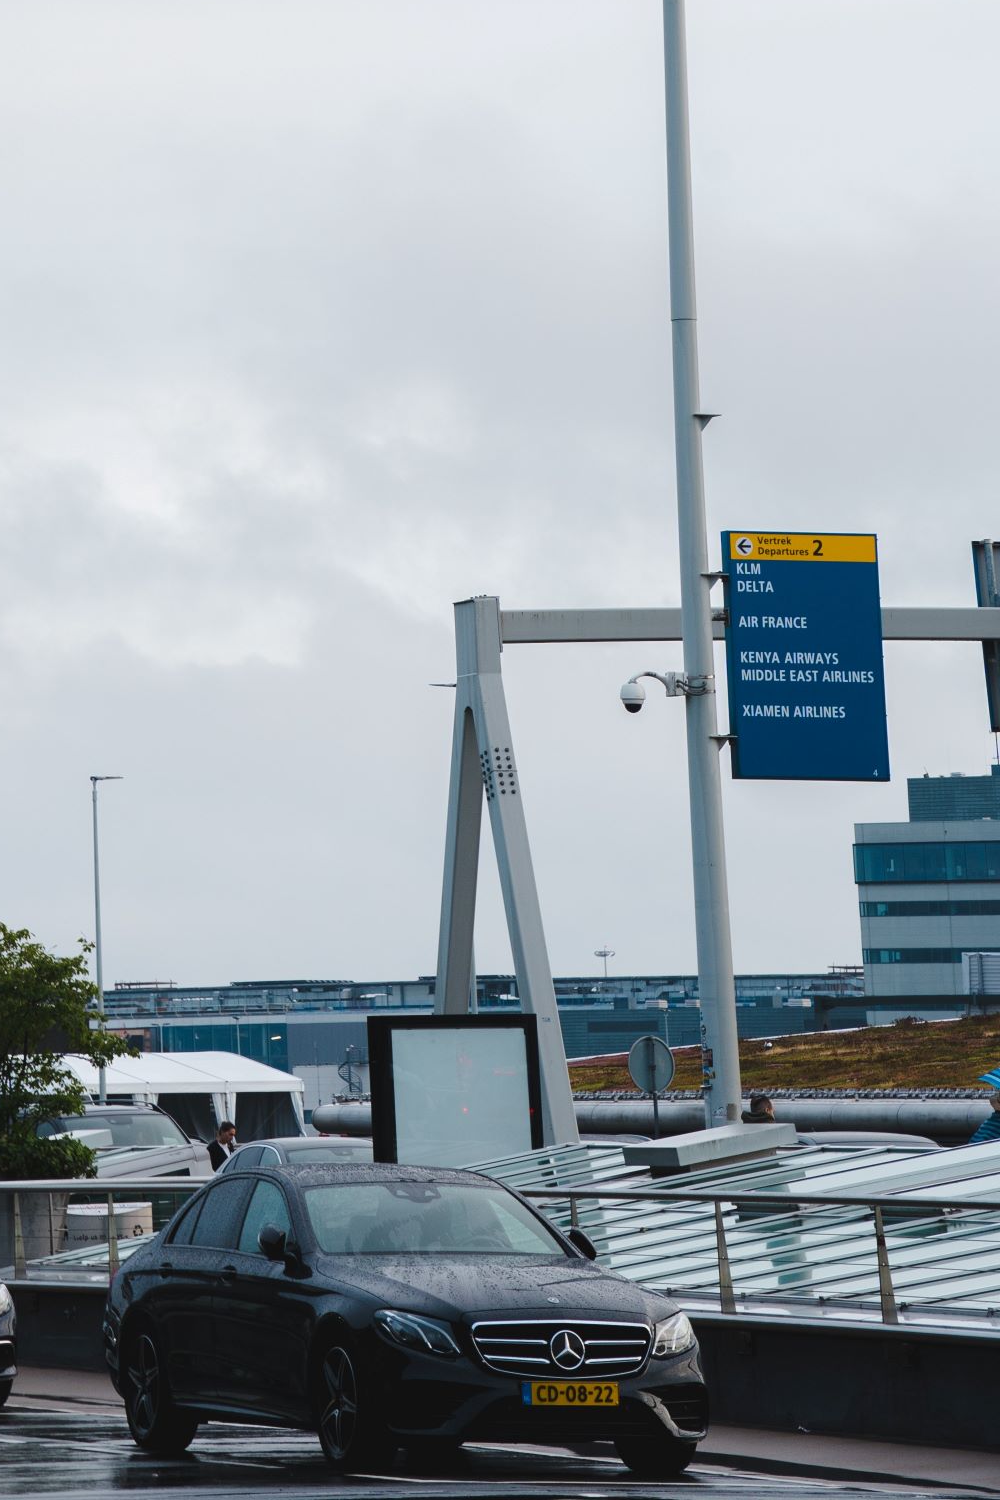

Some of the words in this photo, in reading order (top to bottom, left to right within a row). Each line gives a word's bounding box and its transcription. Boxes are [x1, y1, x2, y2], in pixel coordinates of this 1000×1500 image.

[758, 536, 791, 545] Vertrek
[758, 547, 809, 557] Departures
[812, 540, 823, 556] 2
[736, 563, 761, 575] KLM
[737, 580, 774, 592] DELTA
[739, 616, 758, 628] AIR
[762, 616, 807, 629] FRANCE
[740, 652, 780, 664] KENYA
[785, 652, 839, 665] AIRWAYS
[741, 670, 786, 681] MIDDLE
[790, 670, 819, 682] EAST
[823, 671, 874, 683] AIRLINES
[743, 705, 790, 717] XIAMEN
[794, 706, 845, 718] AIRLINES
[873, 769, 878, 777] 4
[537, 1385, 613, 1403] CD-08-22
